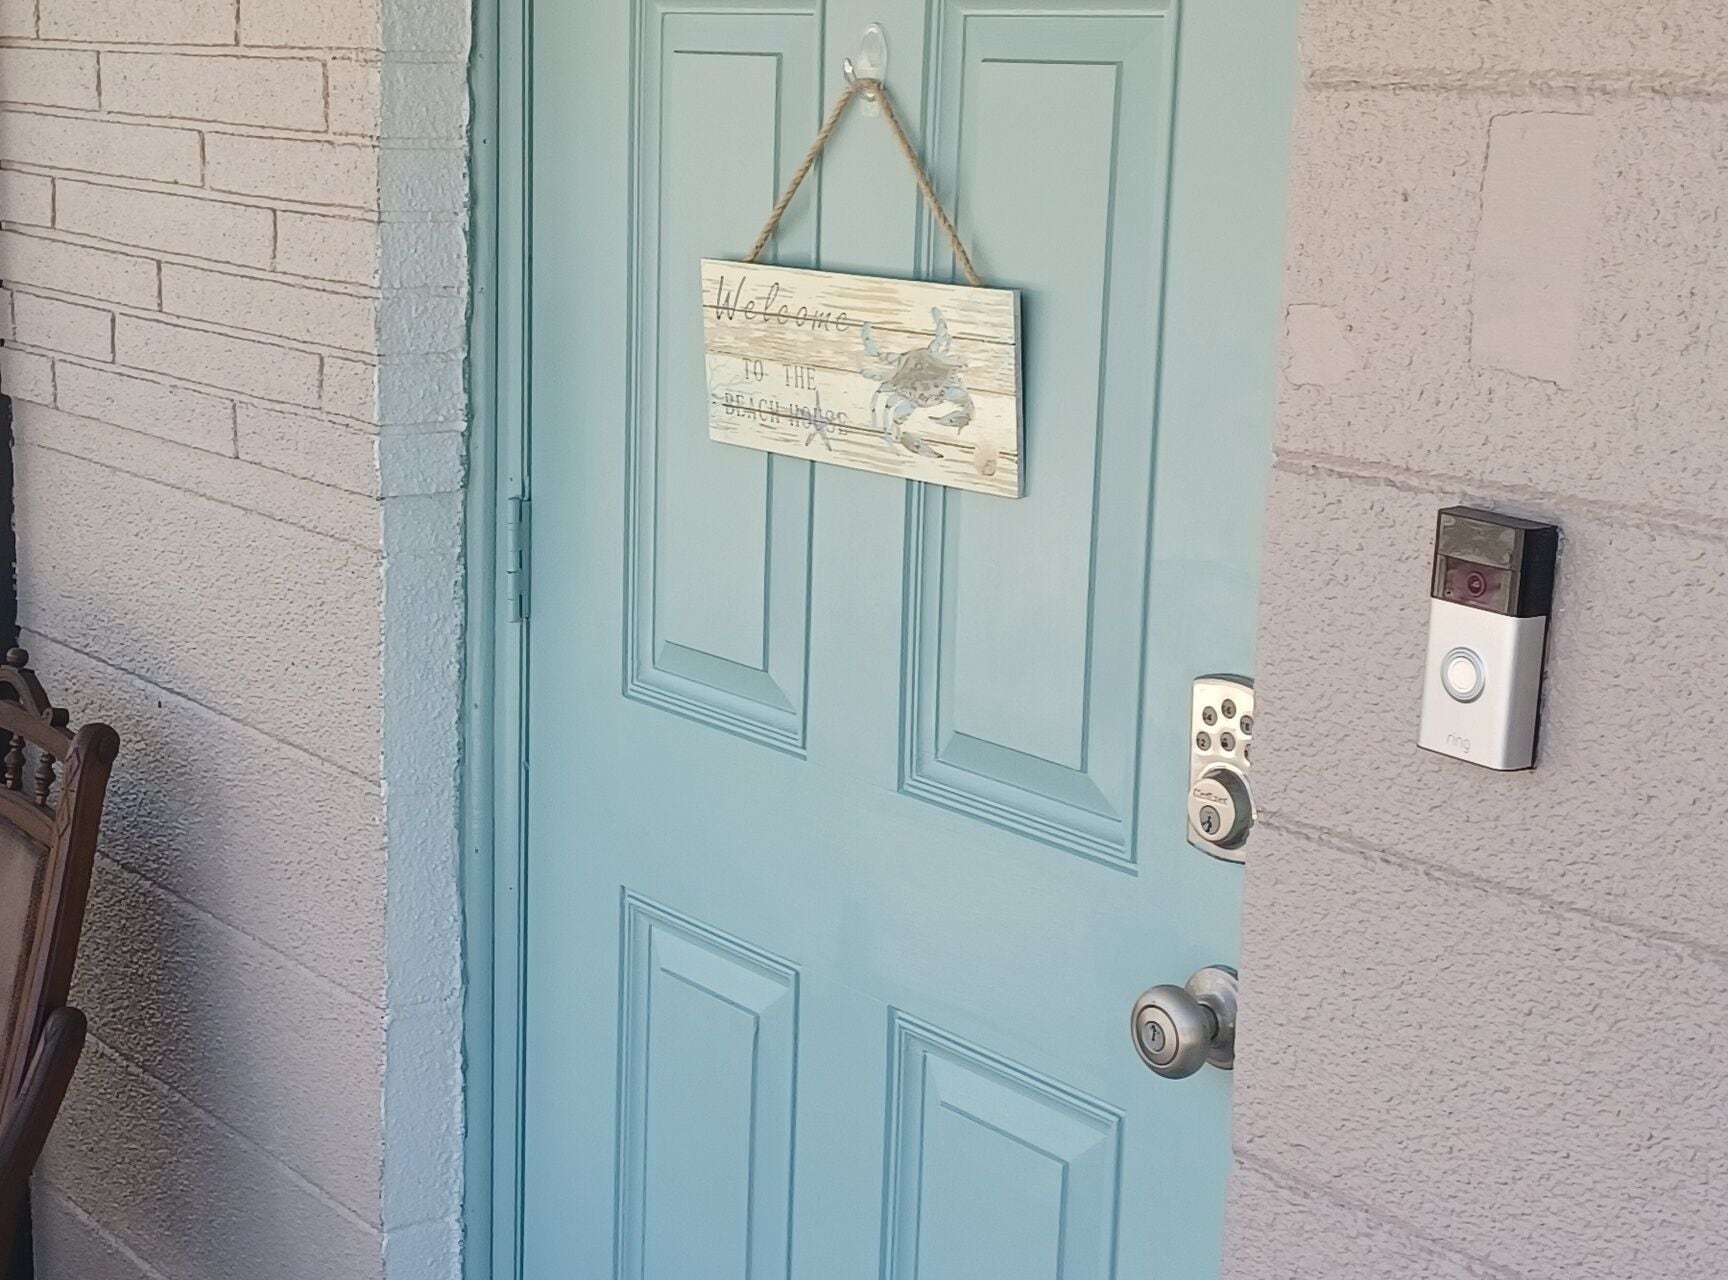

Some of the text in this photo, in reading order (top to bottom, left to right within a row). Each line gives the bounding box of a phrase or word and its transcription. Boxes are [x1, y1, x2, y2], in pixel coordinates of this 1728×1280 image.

[716, 275, 851, 332] Welcome
[742, 357, 817, 391] TO THE
[724, 392, 780, 424] BEACH
